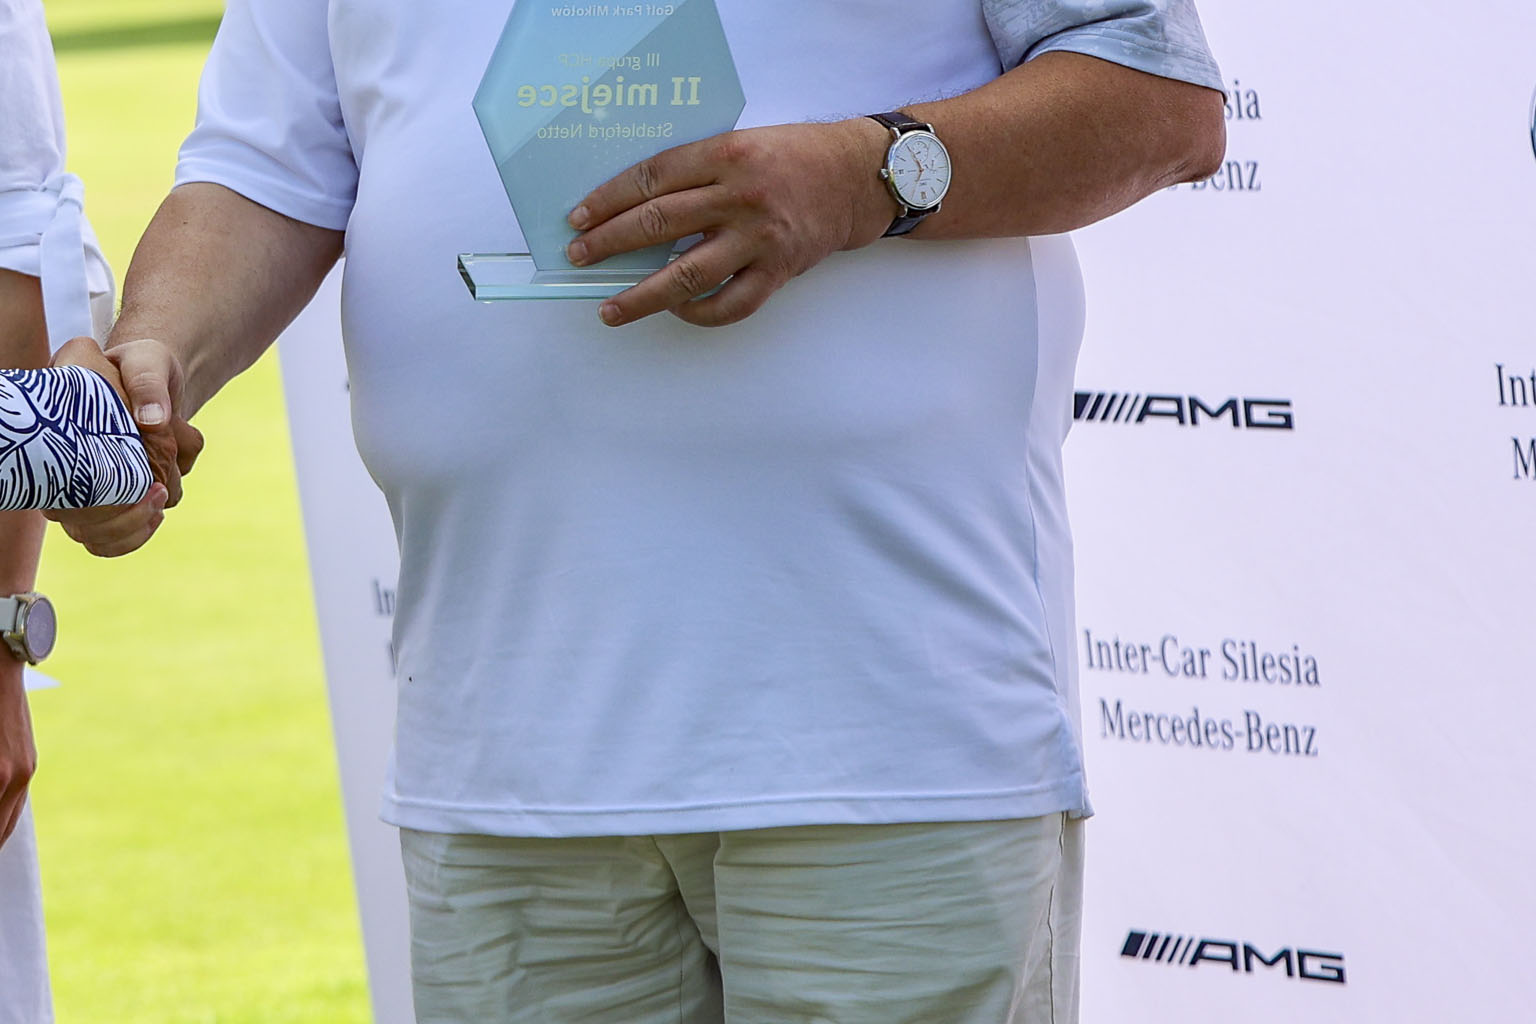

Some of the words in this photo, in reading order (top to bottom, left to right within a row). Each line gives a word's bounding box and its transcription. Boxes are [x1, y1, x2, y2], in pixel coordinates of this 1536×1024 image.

[1135, 392, 1294, 431] AMG
[1084, 628, 1211, 678] Inter-Car
[1221, 638, 1321, 687] Silesia
[1099, 697, 1319, 757] Mercedes-Benz
[1189, 937, 1348, 984] AMG
